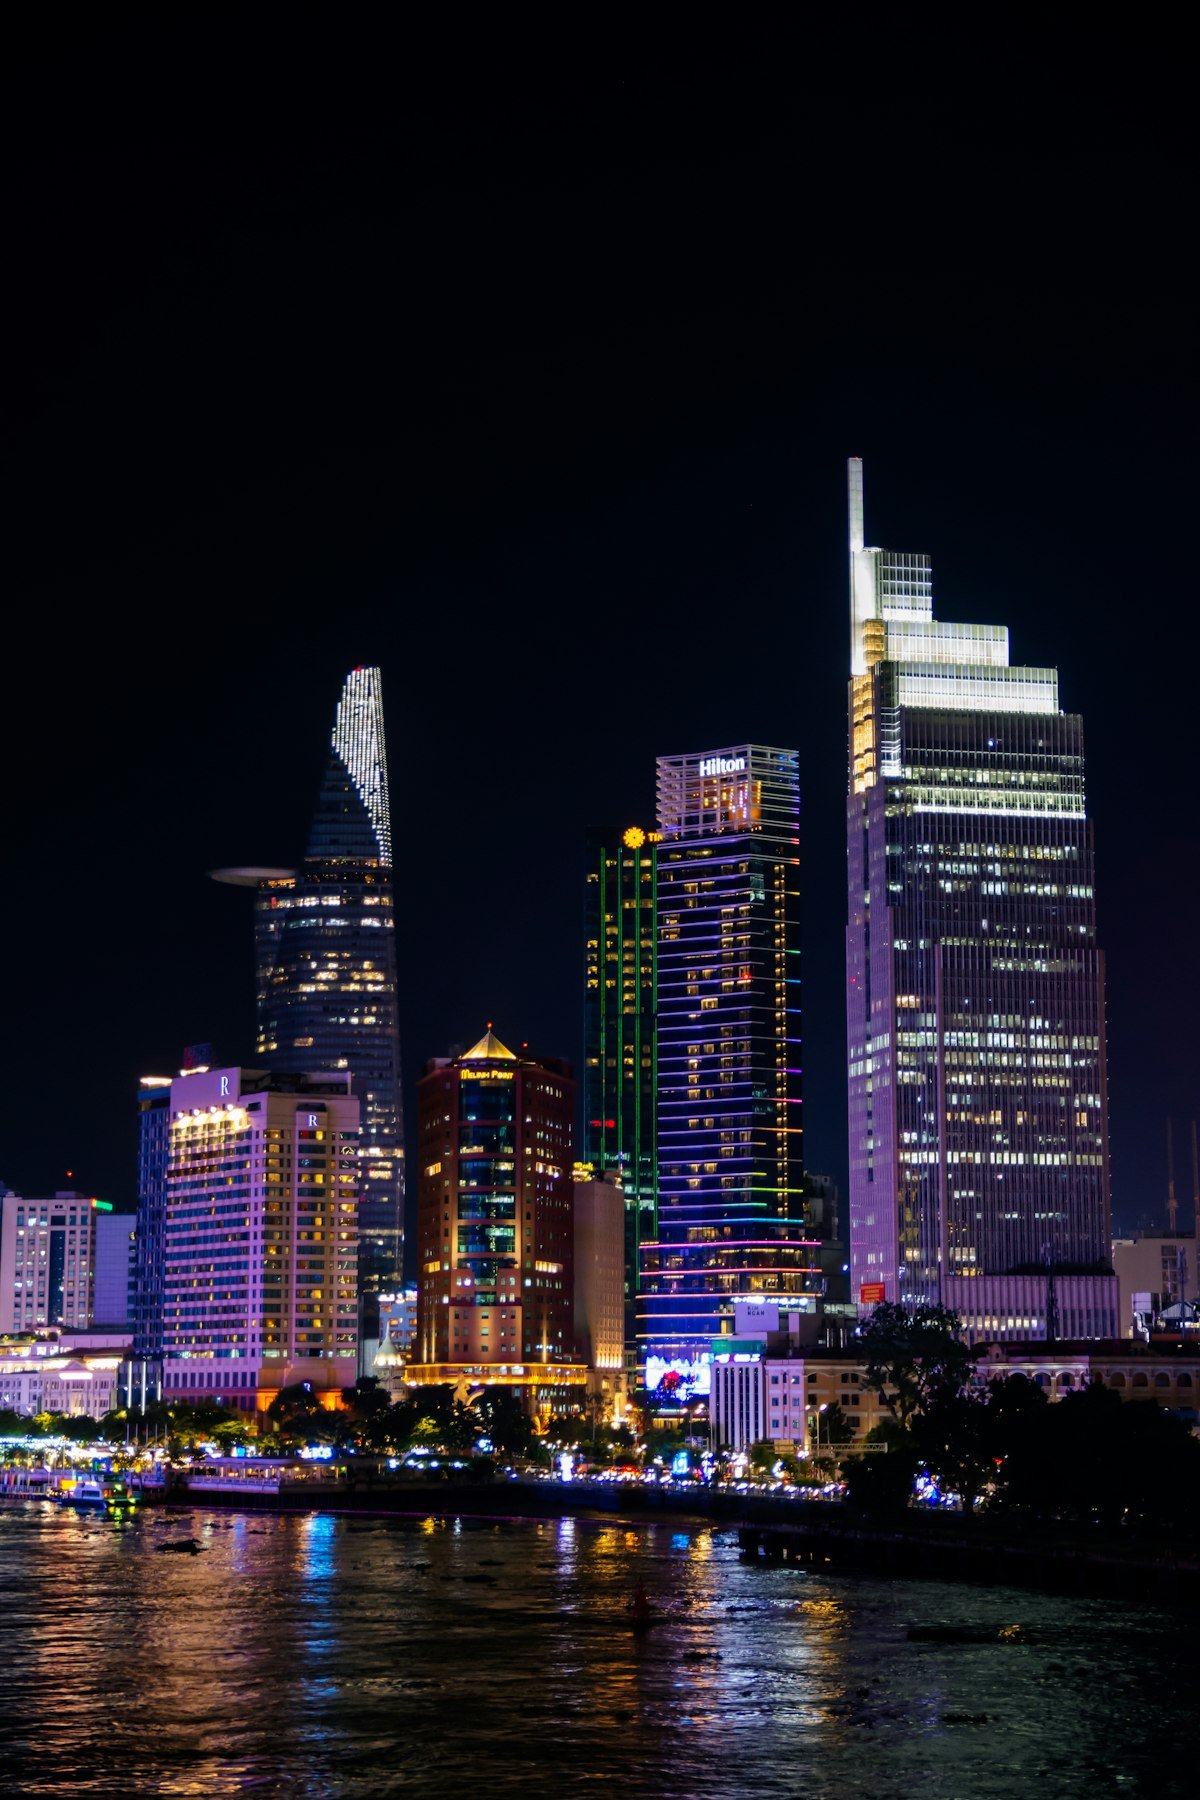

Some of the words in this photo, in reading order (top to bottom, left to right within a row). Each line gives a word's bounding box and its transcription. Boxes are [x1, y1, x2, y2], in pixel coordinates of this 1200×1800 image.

[700, 757, 745, 777] Hilton
[491, 1070, 514, 1080] POINT
[220, 1076, 230, 1096] R
[308, 1113, 318, 1127] R
